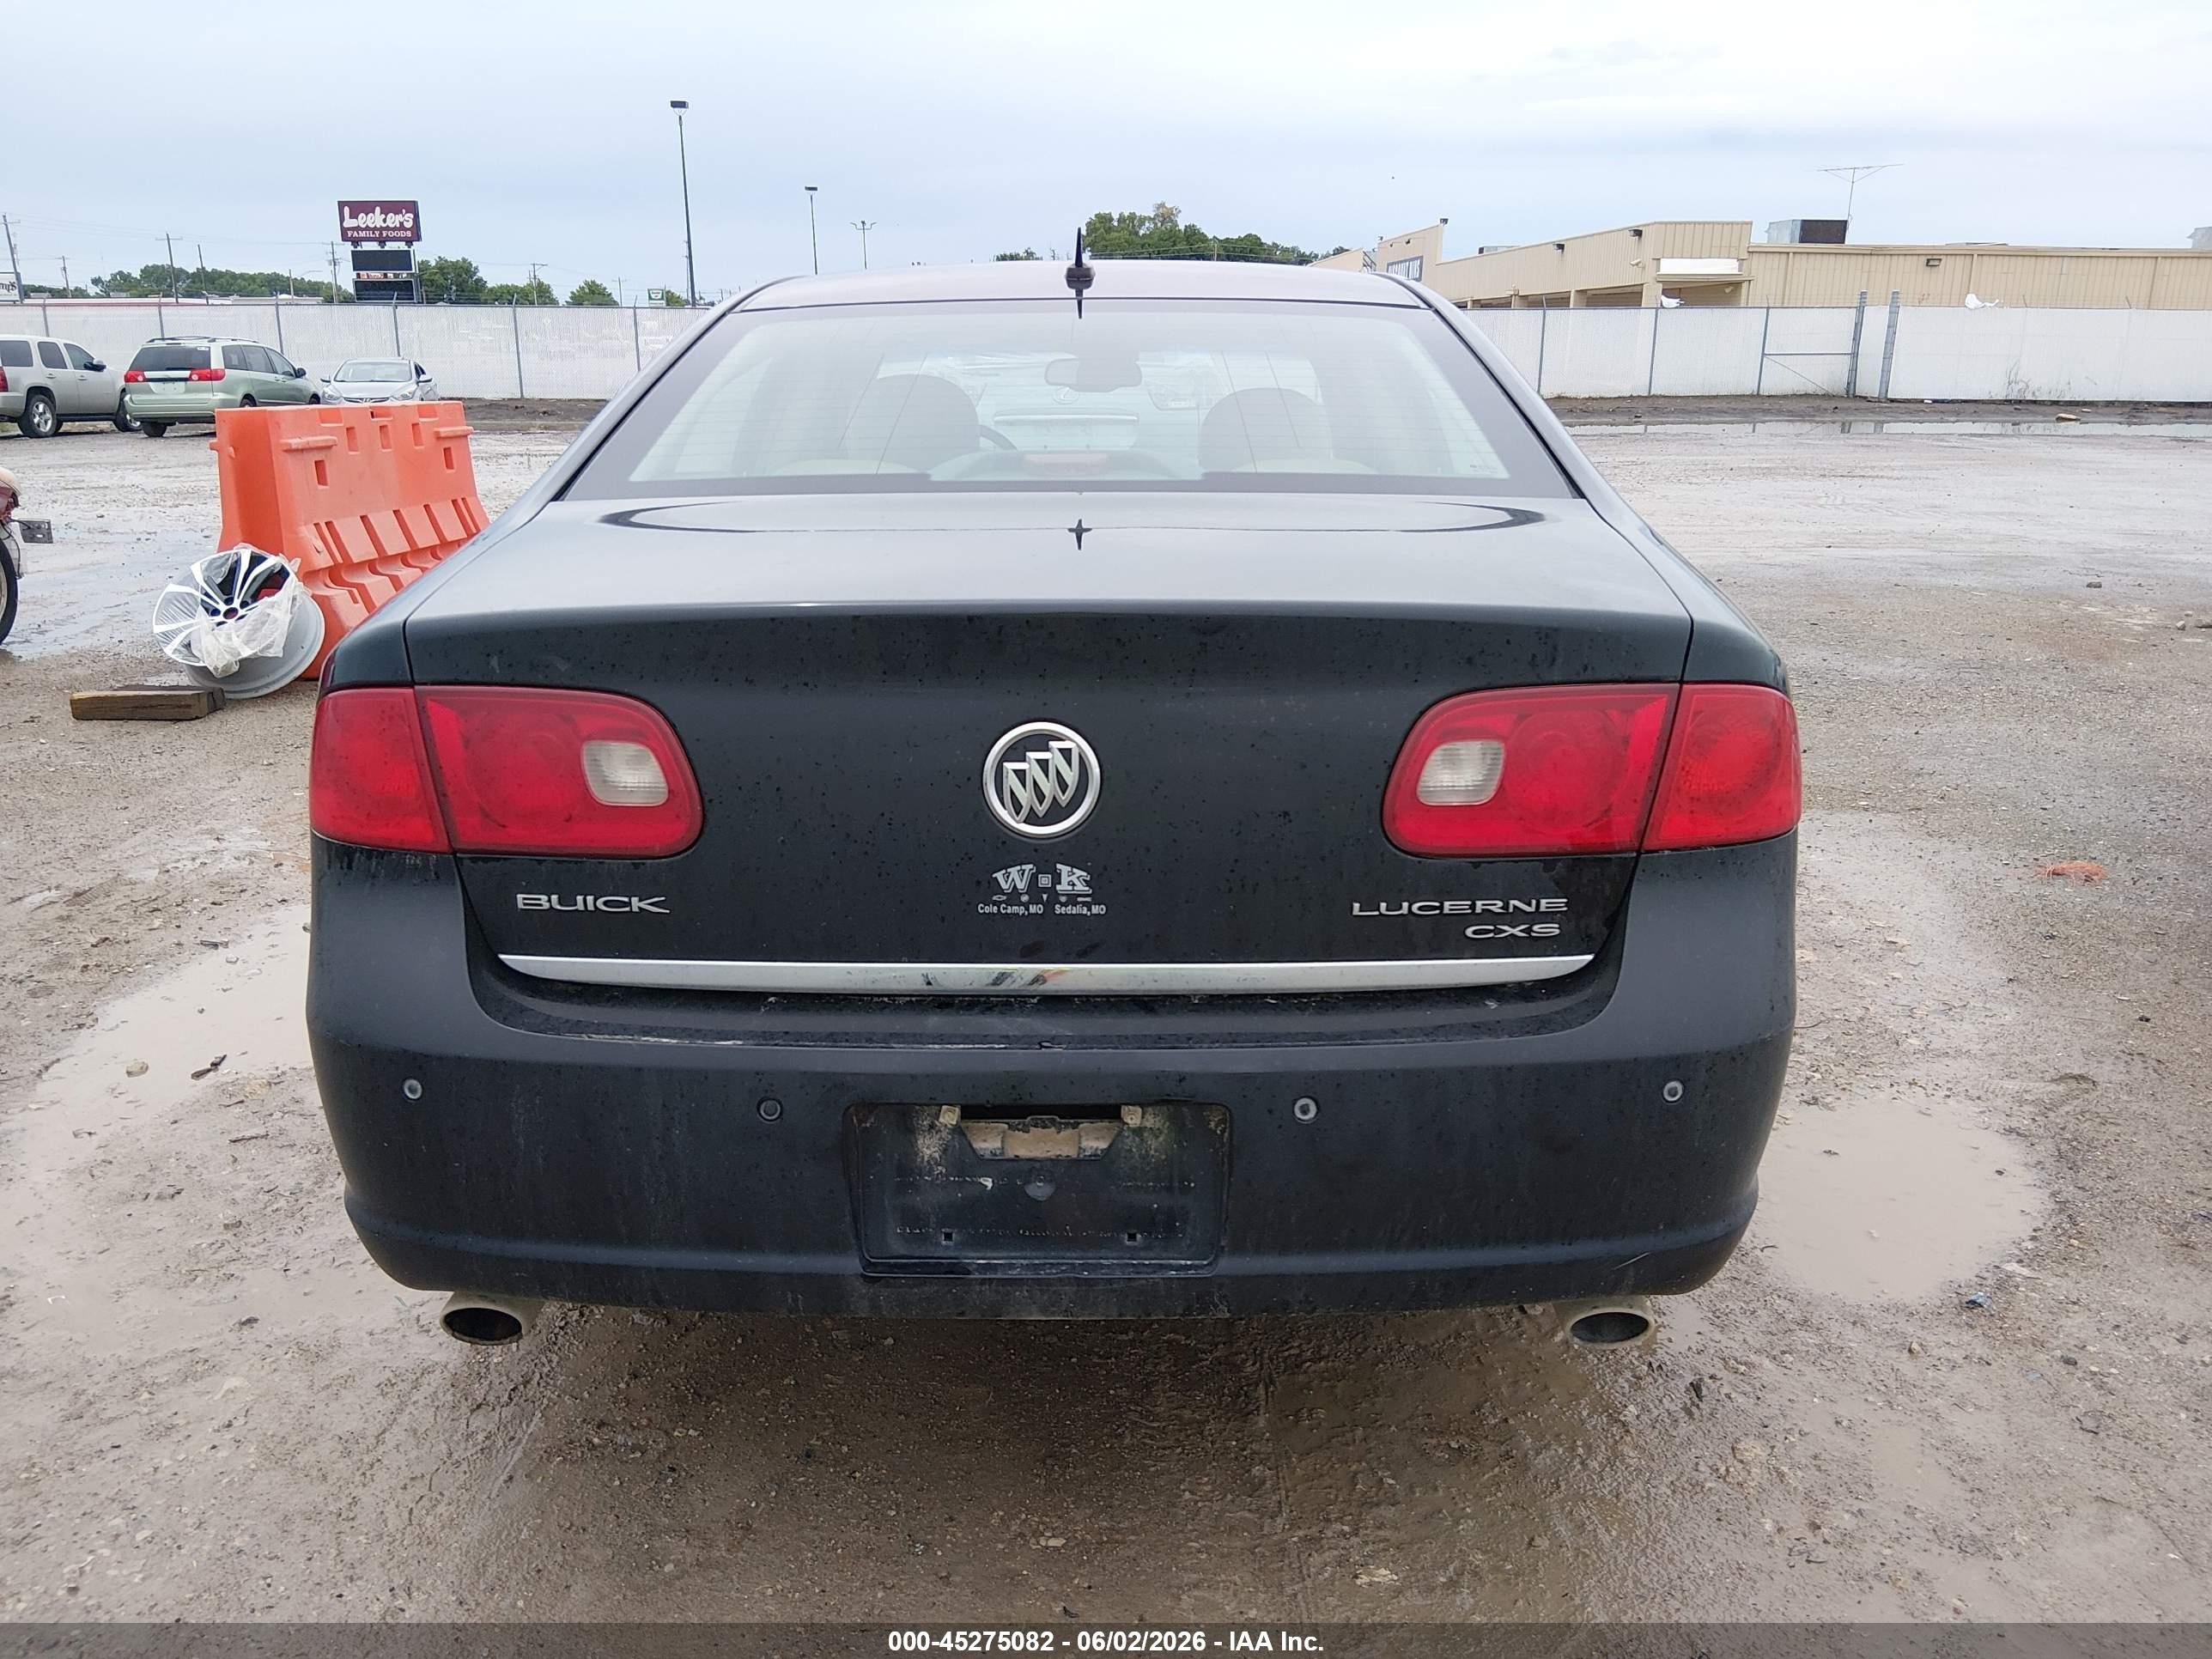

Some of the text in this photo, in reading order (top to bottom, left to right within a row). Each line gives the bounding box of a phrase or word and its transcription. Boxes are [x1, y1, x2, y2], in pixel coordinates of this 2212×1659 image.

[343, 206, 414, 228] Leeker's
[992, 863, 1092, 894] W K
[516, 894, 671, 914] BUICK
[978, 903, 998, 914] Cole
[1352, 898, 1568, 916] LUCERNE
[1465, 923, 1561, 939] CXS
